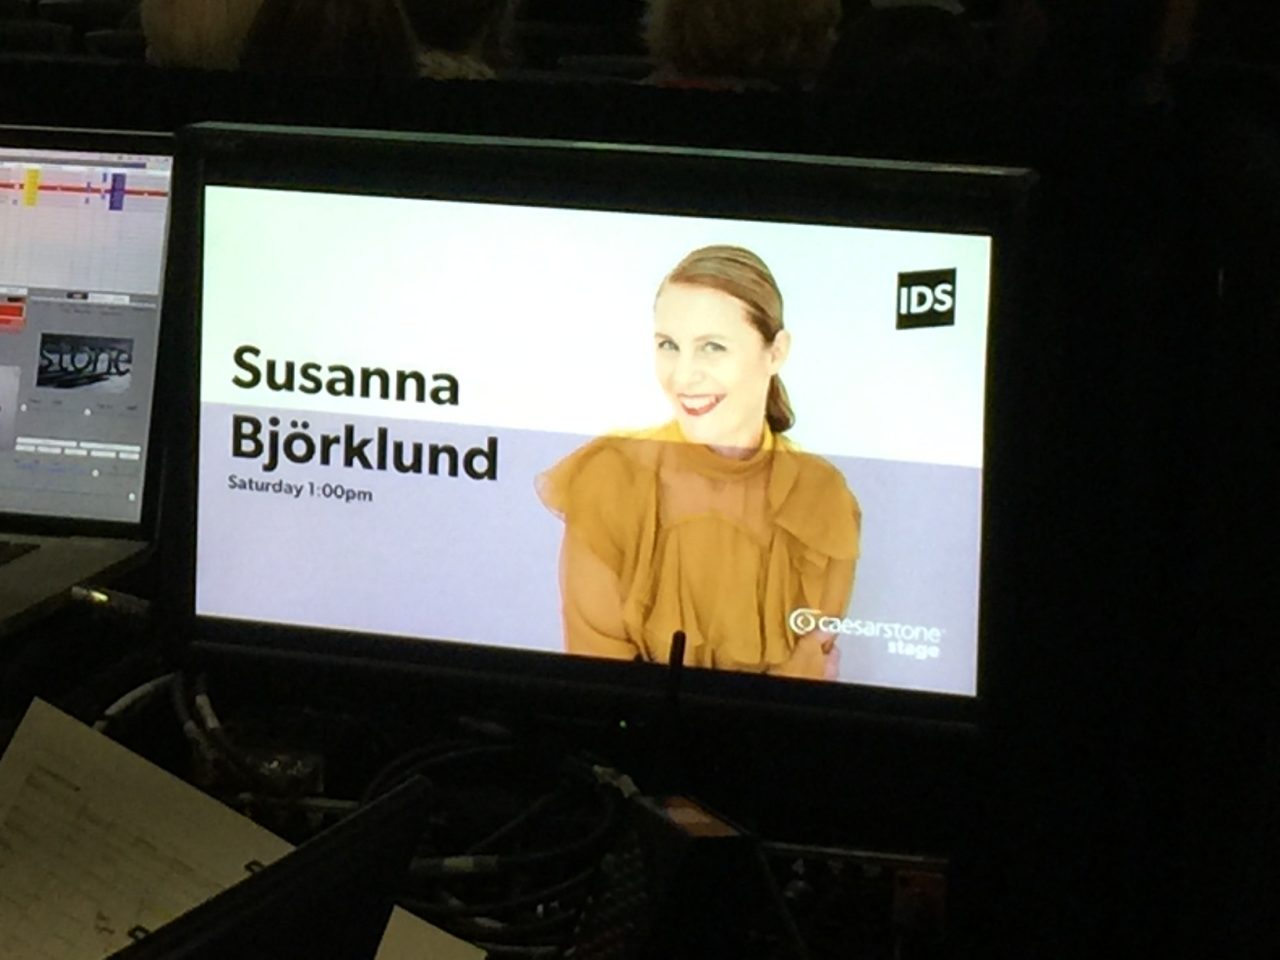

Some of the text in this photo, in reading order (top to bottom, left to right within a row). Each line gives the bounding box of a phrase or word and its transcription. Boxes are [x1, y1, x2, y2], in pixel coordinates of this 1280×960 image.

[900, 282, 953, 314] IDS
[231, 344, 460, 407] Susanna
[231, 413, 499, 482] Björklund
[227, 474, 374, 504] Saturday 1:00pm
[887, 640, 941, 660] stage
